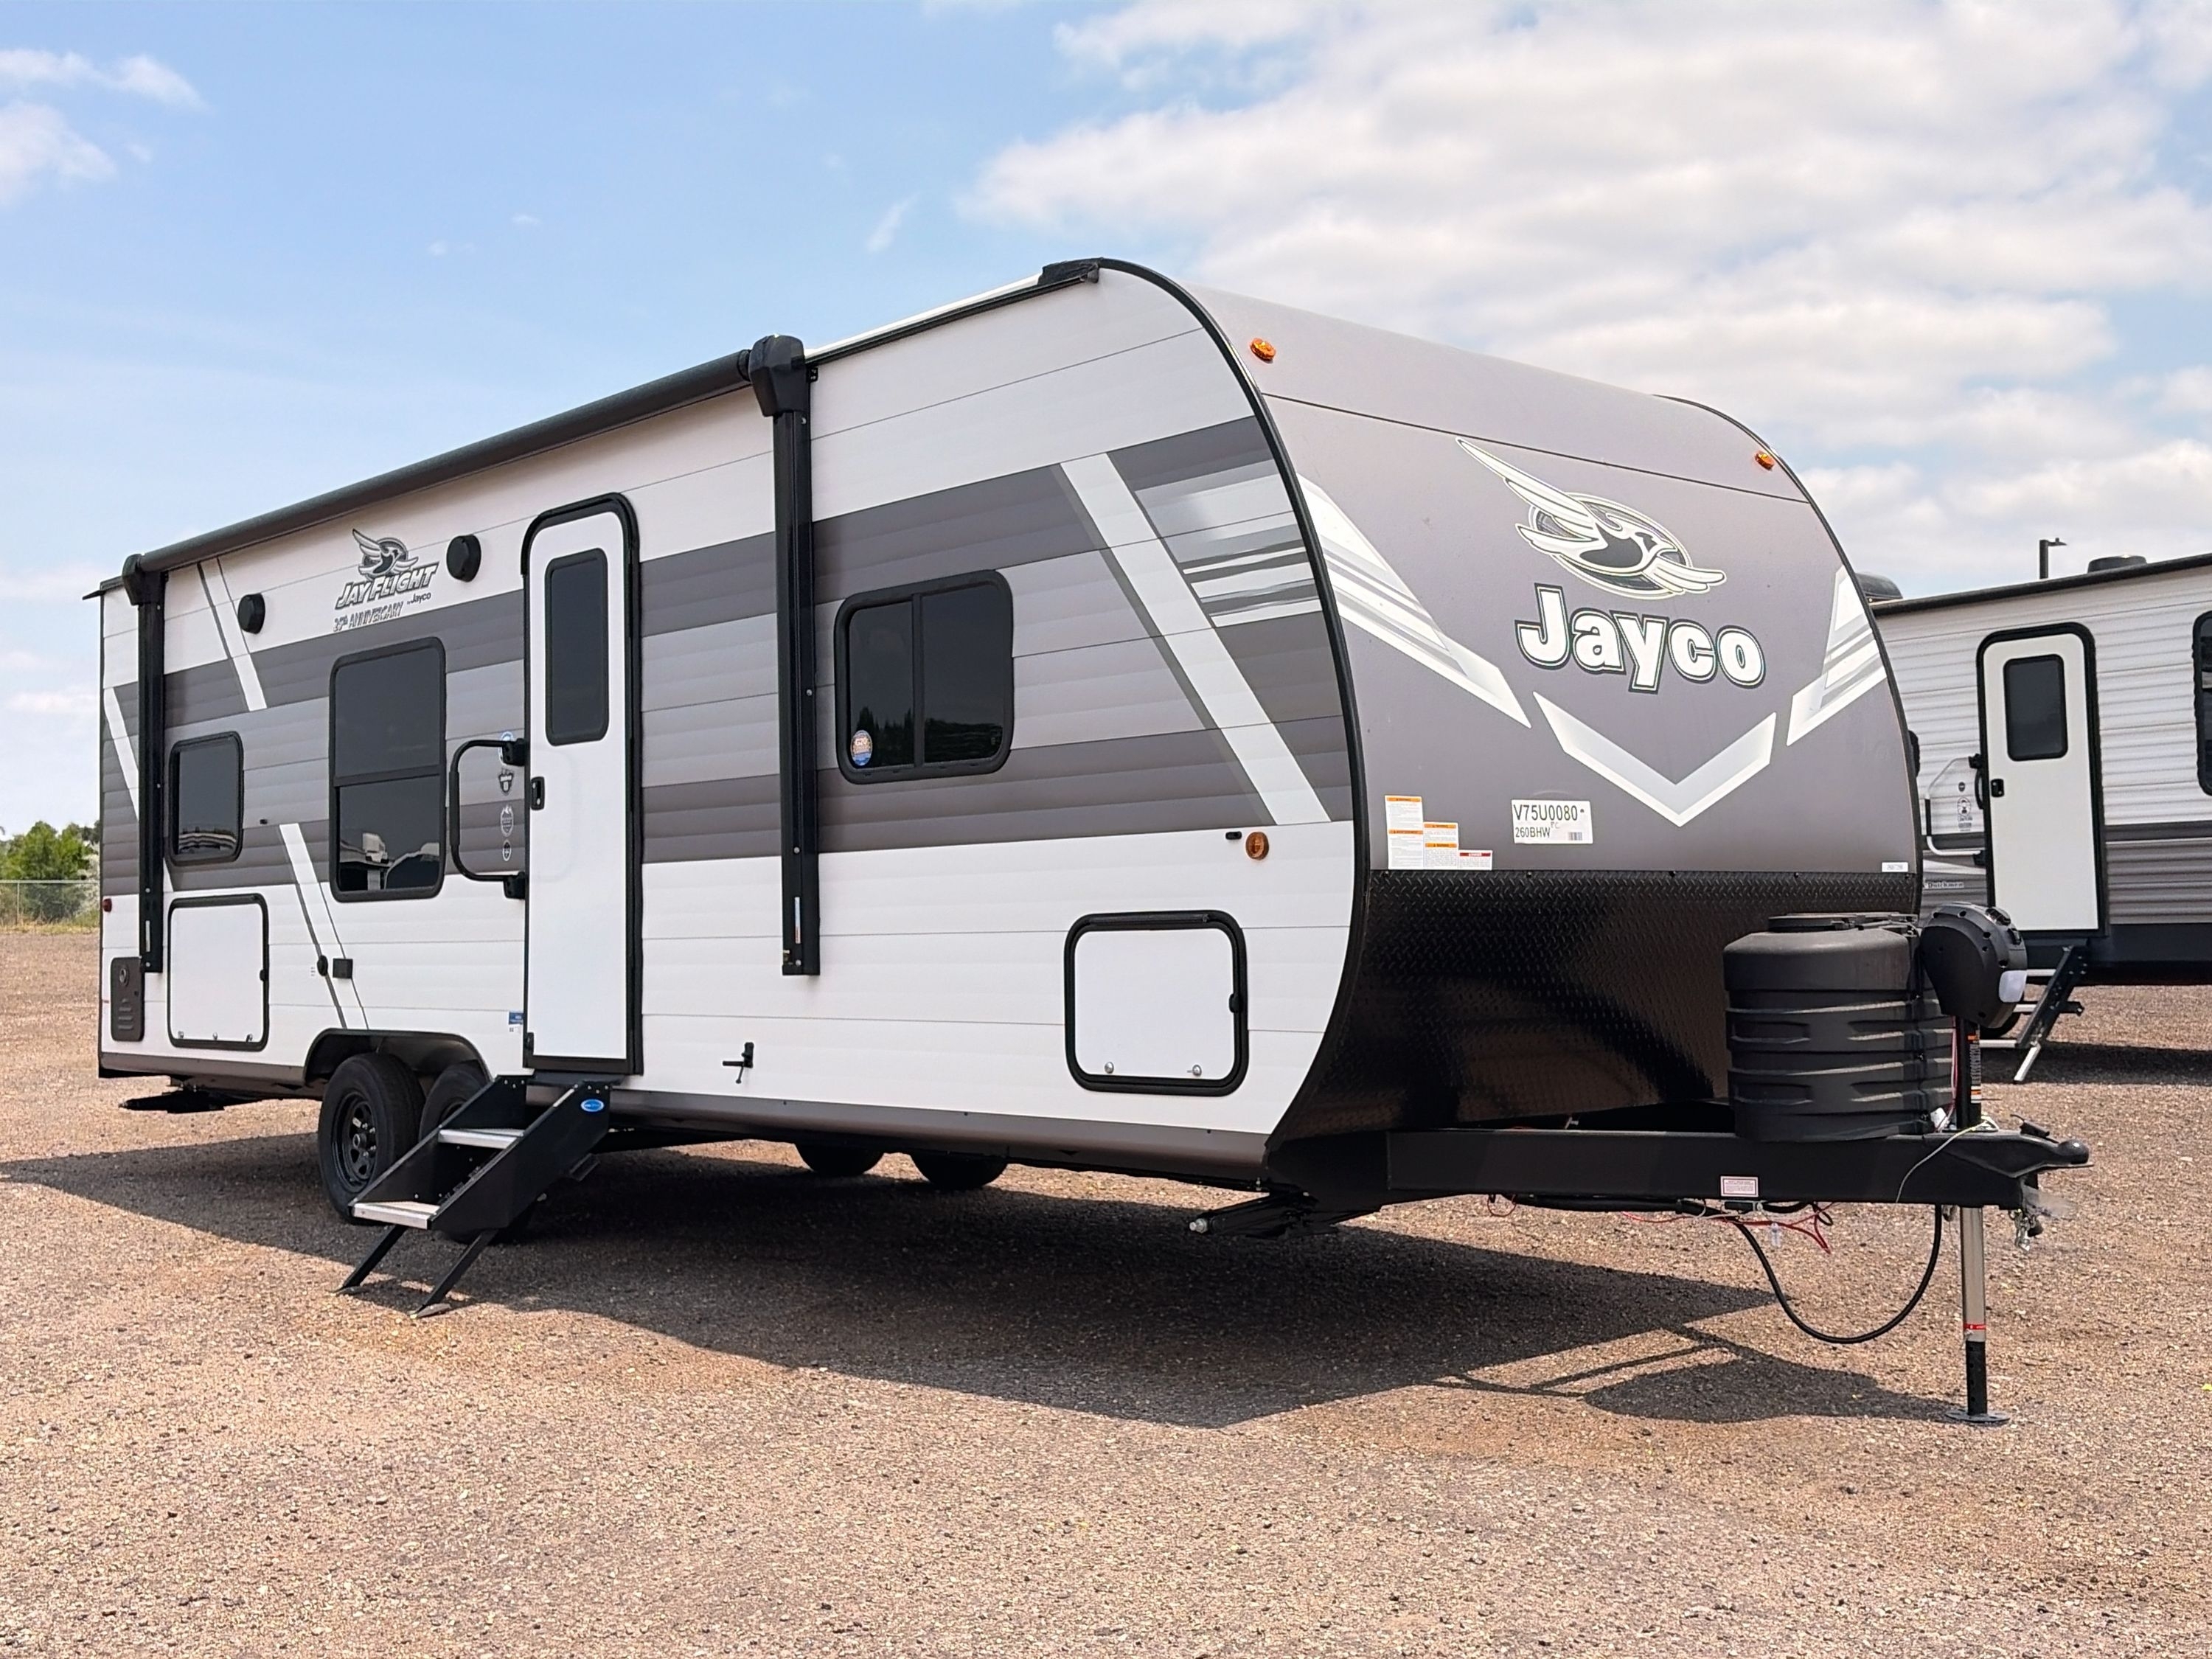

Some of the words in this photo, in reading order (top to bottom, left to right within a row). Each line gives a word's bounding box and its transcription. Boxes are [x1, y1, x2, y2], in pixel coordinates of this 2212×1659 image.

[335, 581, 372, 610] JAY
[367, 562, 439, 602] FLIGHT
[411, 592, 431, 604] Jayco
[1514, 582, 1766, 695] Jayco
[1513, 804, 1578, 821] V75U0080
[1515, 827, 1551, 838] 260BHW
